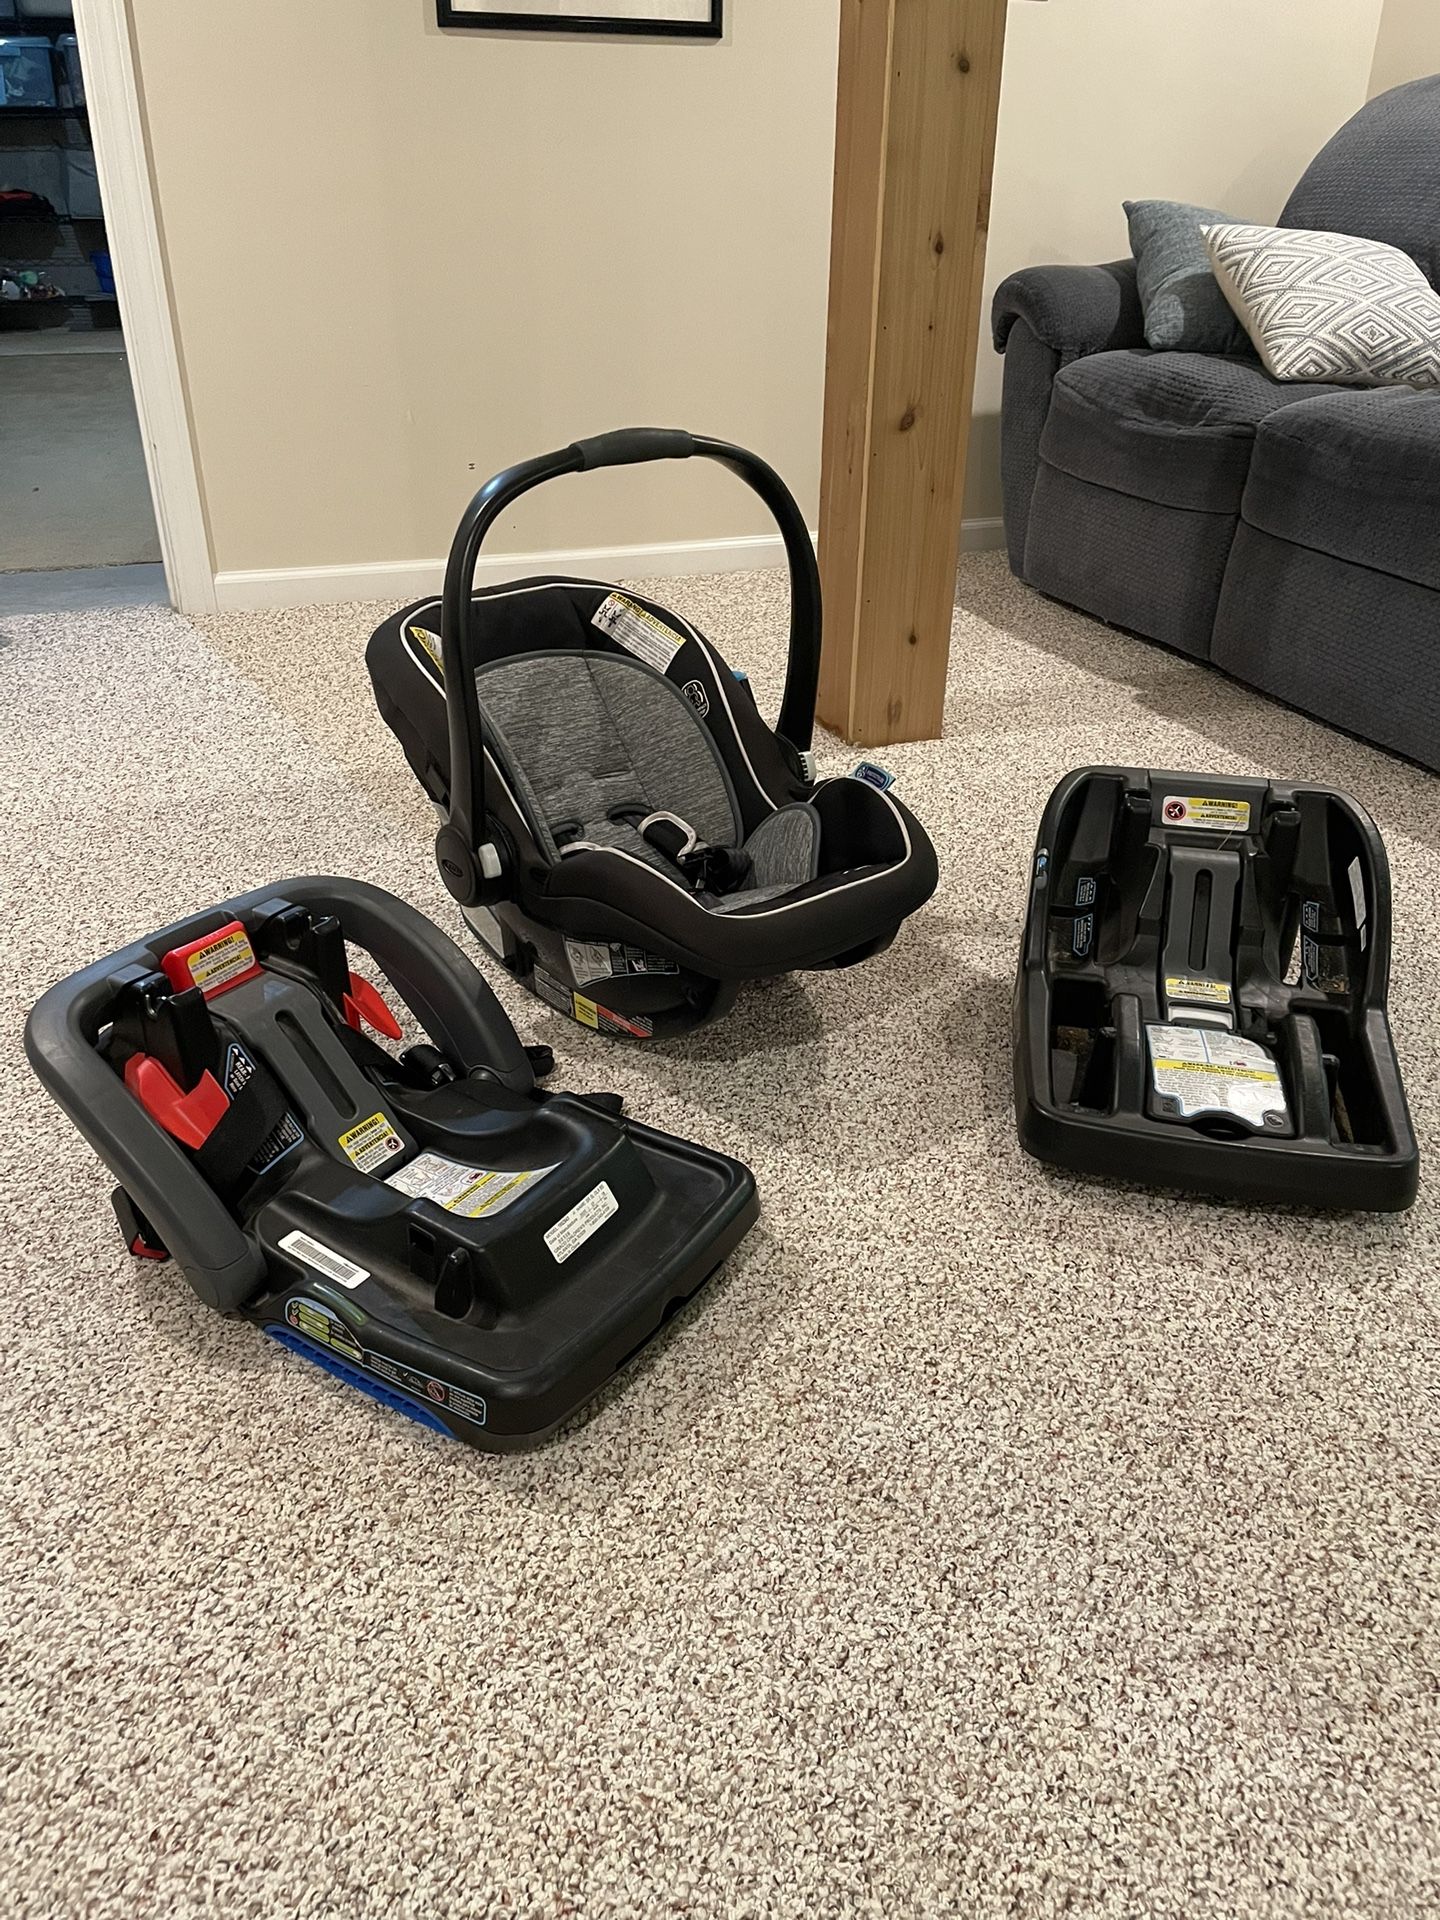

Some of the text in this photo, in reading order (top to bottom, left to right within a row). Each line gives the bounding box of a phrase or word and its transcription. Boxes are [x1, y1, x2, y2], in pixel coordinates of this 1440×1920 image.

[1208, 800, 1238, 808] WARNING!
[203, 936, 234, 955] WARNING!
[351, 1117, 380, 1140] WARNING!
